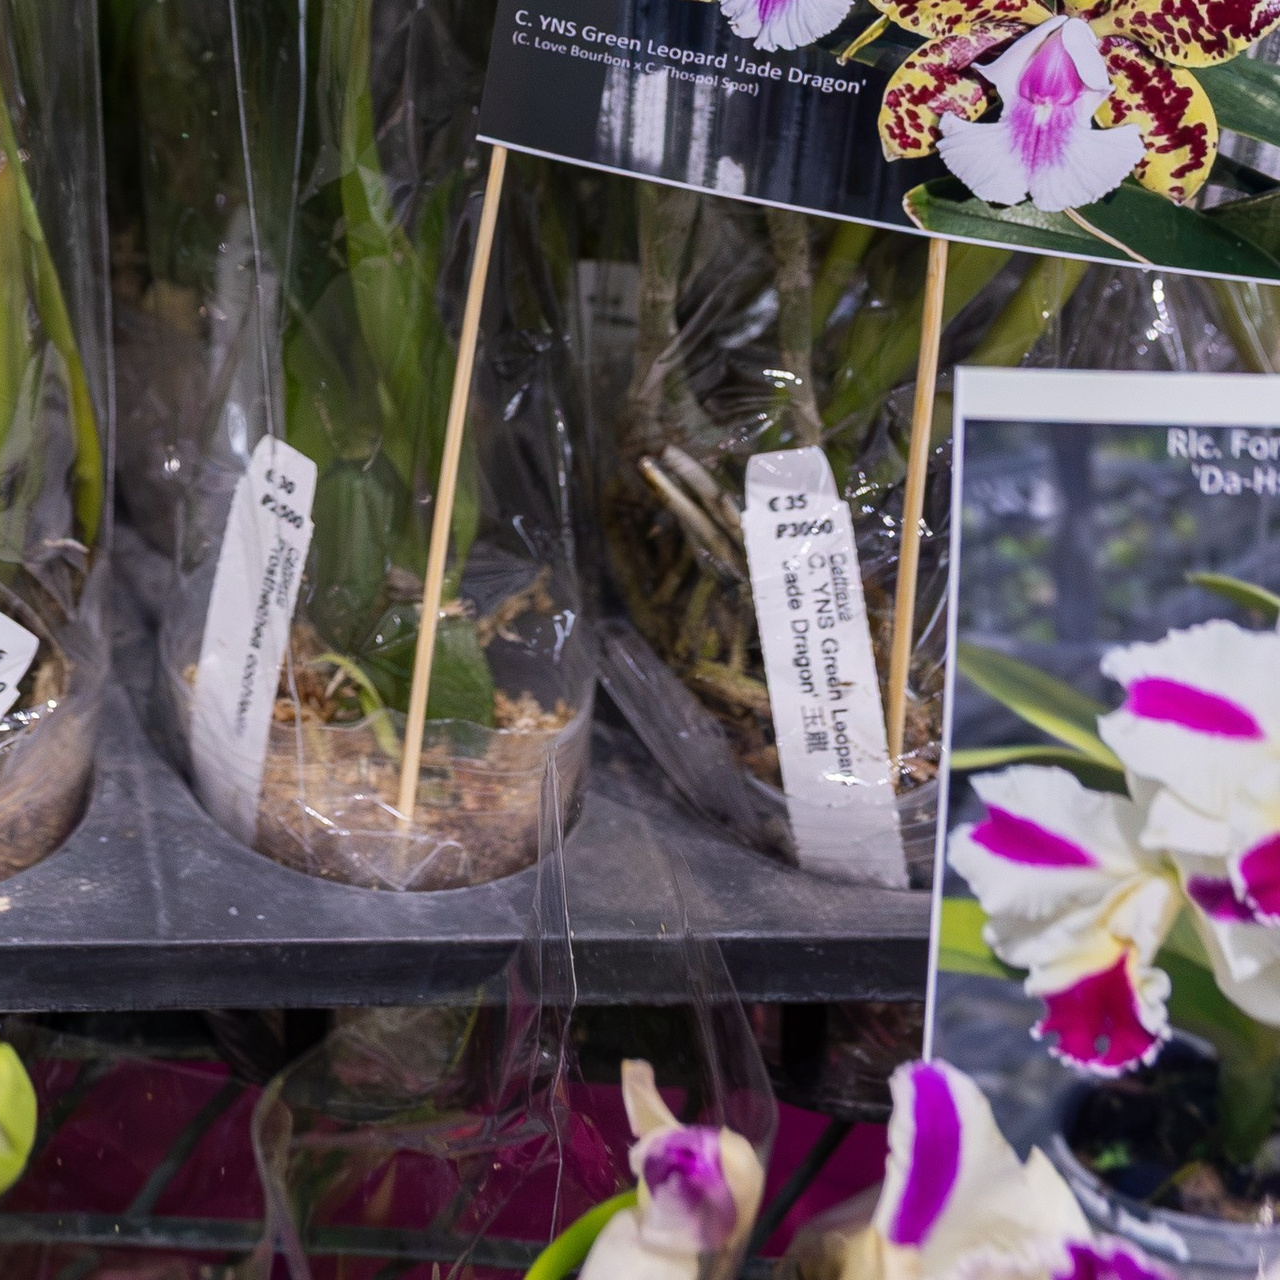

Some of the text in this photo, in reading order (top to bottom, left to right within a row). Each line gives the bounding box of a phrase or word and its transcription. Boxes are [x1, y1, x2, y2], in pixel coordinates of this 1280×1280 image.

[512, 32, 531, 46] (C.
[535, 38, 567, 55] Love
[570, 45, 631, 70] Bourbon
[515, 10, 867, 95] C. YNS Green Leopard 'Jade Dragon'
[1191, 462, 1280, 496] 'Da-H
[814, 582, 836, 629] YNS
[822, 637, 843, 701] Green
